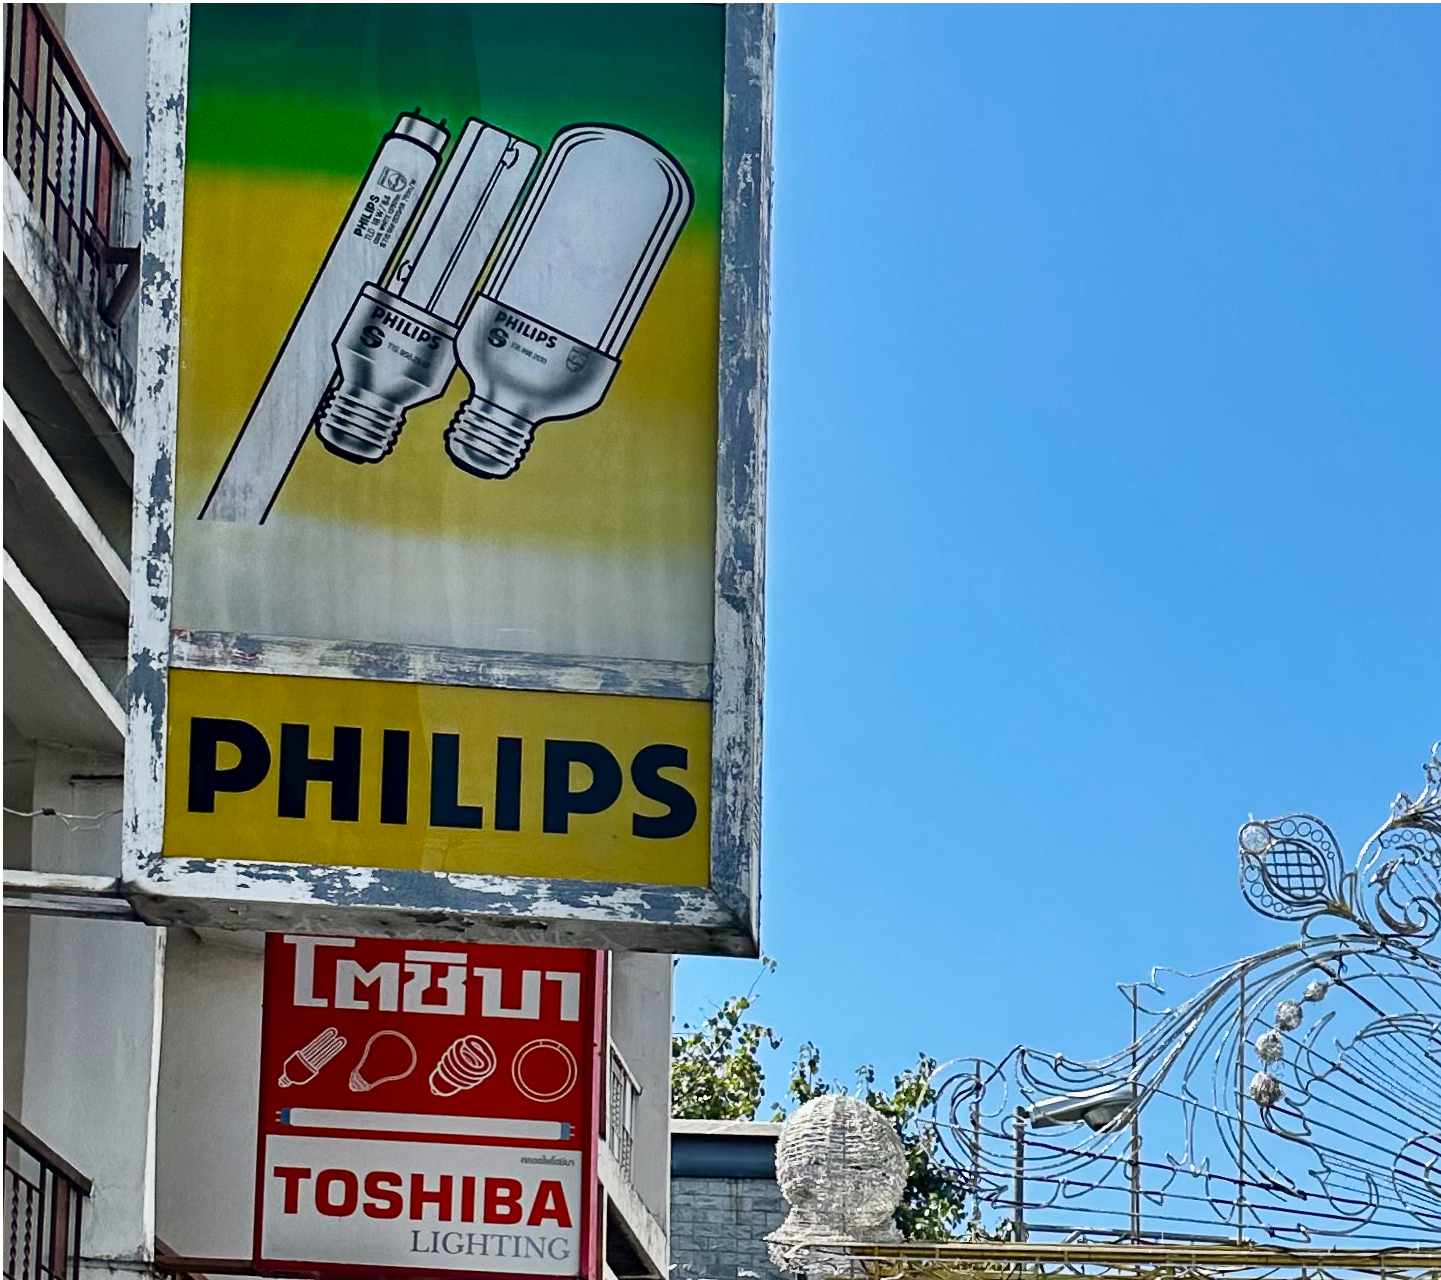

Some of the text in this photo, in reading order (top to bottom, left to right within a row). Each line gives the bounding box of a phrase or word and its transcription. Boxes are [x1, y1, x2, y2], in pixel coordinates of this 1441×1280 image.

[353, 194, 380, 237] PHILIPS
[370, 306, 442, 350] PHILIPS
[494, 311, 558, 349] PHILIPS
[187, 716, 697, 840] PHILIPS
[283, 934, 581, 1022] โตชิบา
[273, 1166, 573, 1229] TOSHIBA
[410, 1229, 570, 1261] LIGHTING
